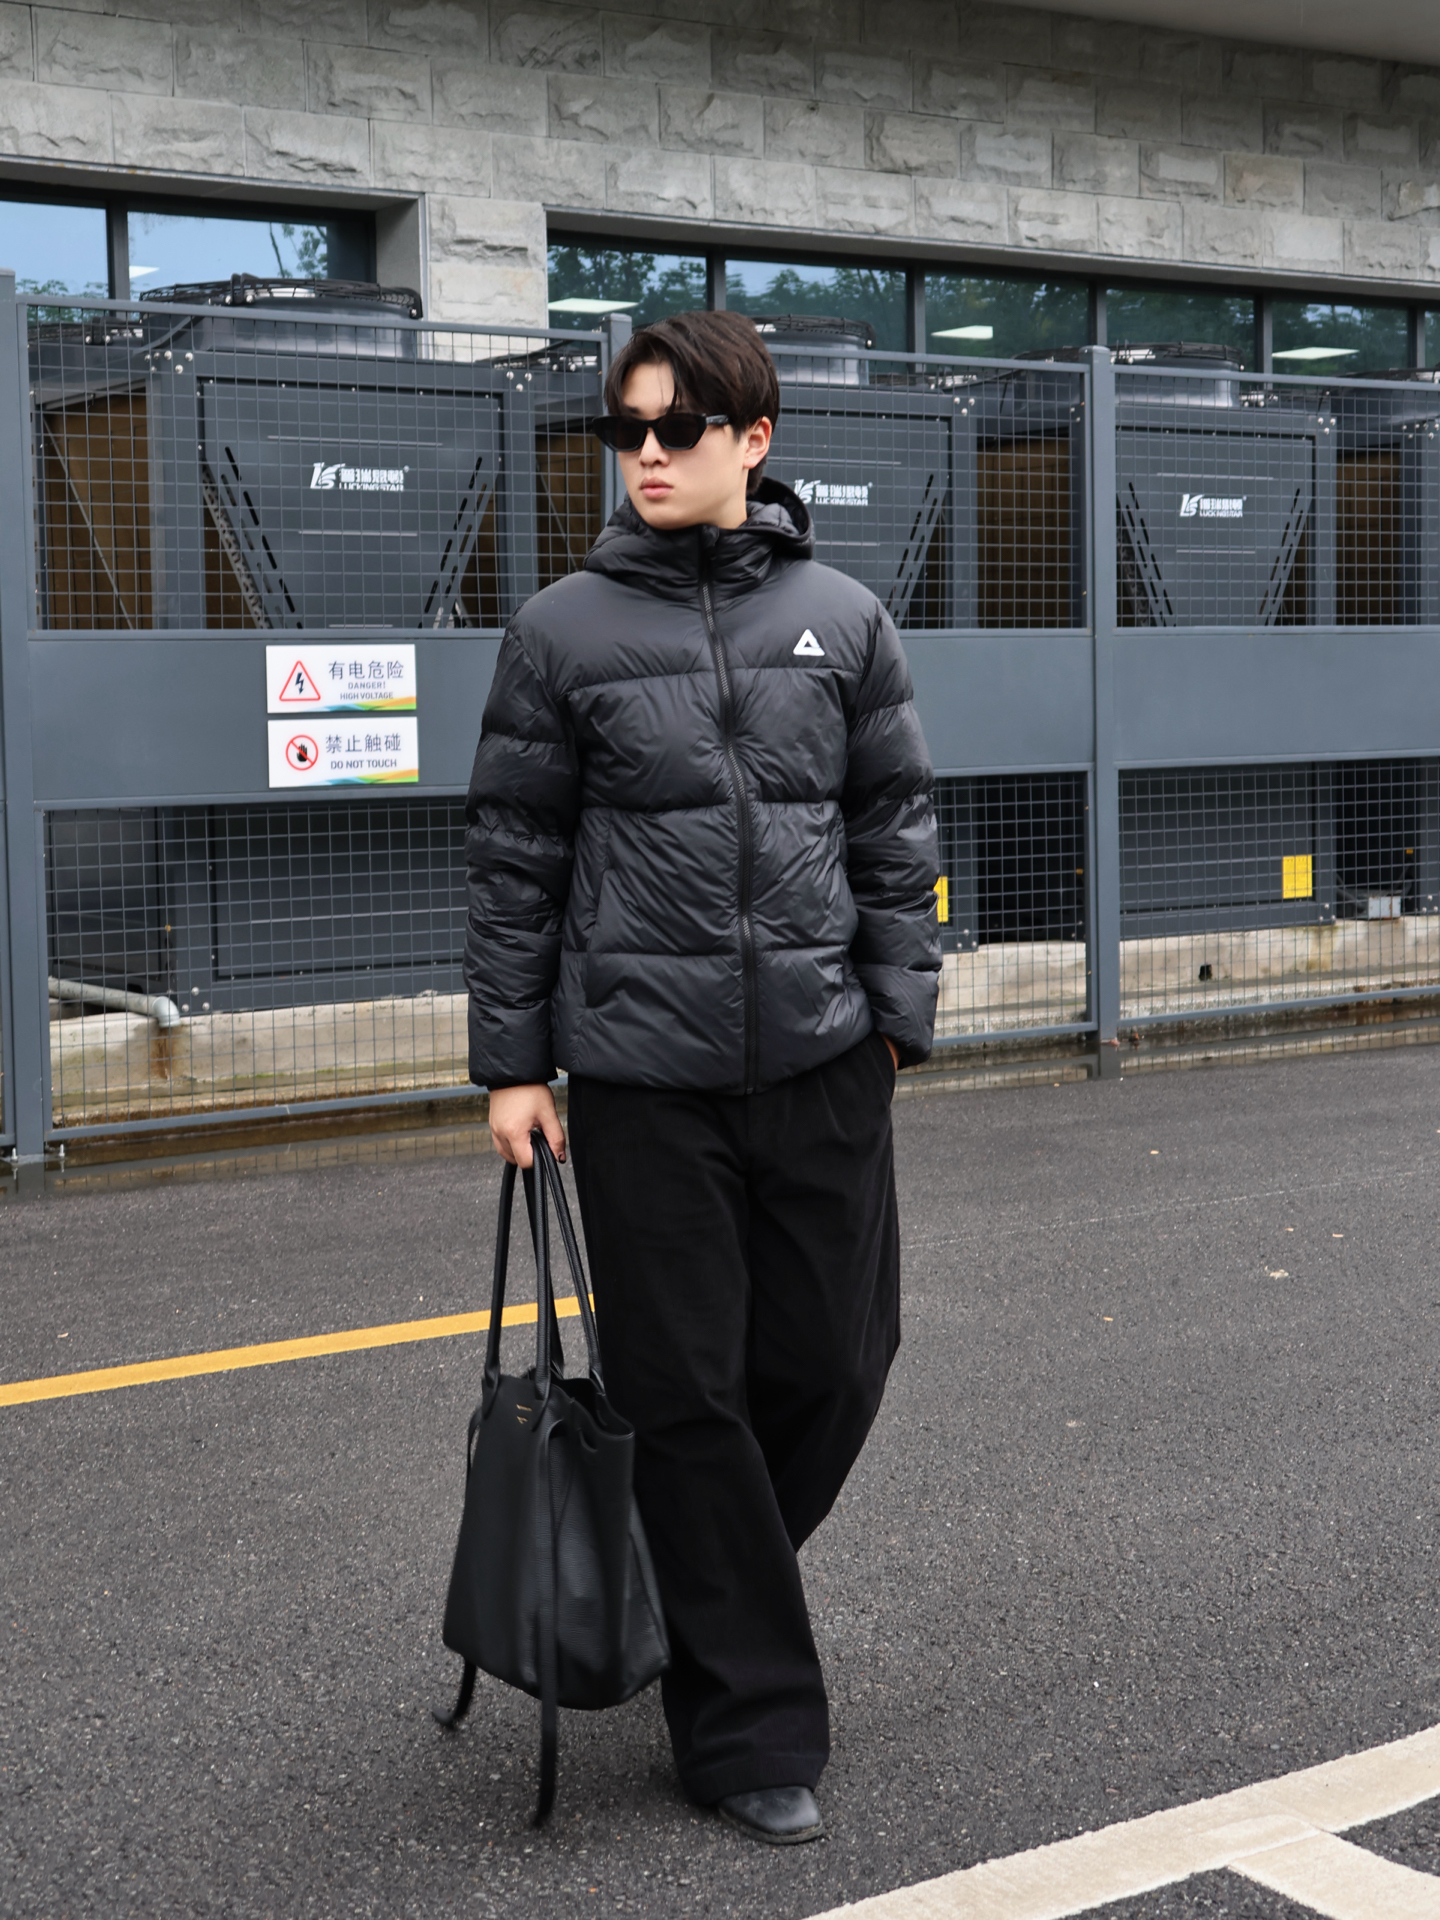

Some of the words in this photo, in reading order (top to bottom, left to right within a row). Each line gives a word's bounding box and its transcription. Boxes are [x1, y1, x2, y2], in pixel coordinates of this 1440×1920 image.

[328, 660, 404, 680] 有电危险
[348, 681, 386, 690] DANGER!
[340, 692, 359, 700] HIGH
[360, 691, 394, 700] VOLTAGE
[325, 732, 402, 754] 禁止触碰
[330, 760, 344, 770] DO
[345, 759, 364, 769] NOT
[366, 758, 397, 768] TOUCH
